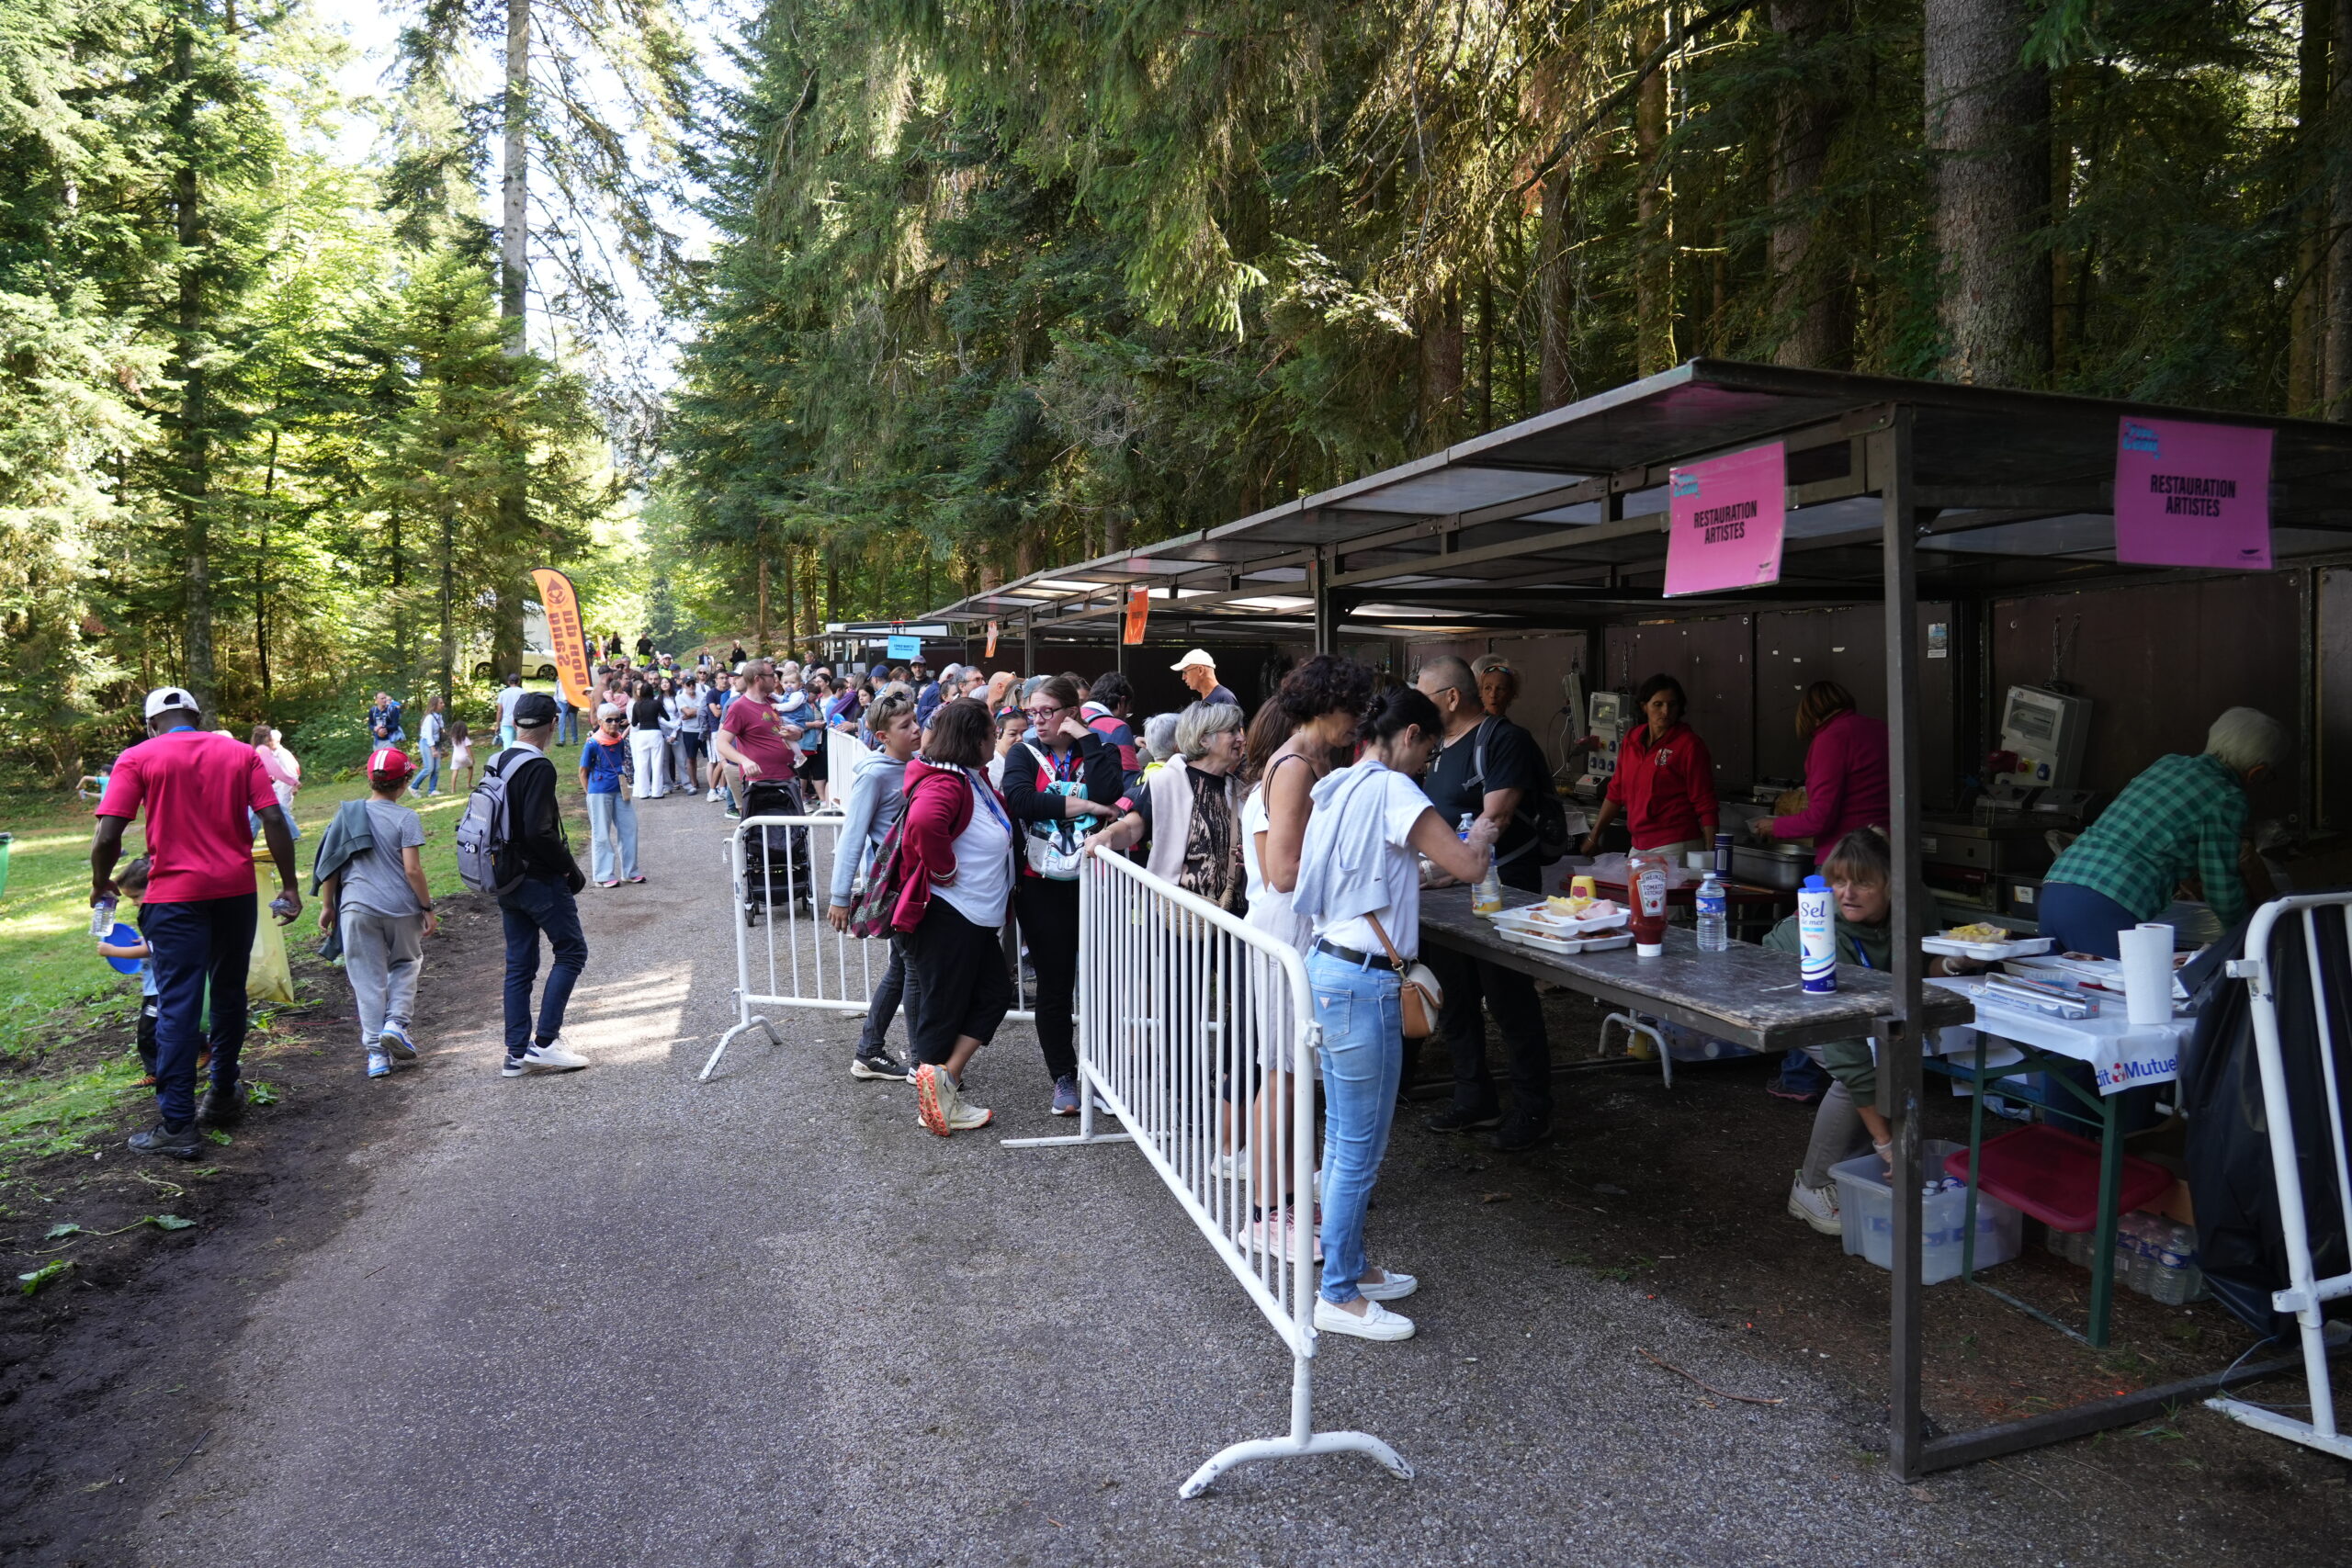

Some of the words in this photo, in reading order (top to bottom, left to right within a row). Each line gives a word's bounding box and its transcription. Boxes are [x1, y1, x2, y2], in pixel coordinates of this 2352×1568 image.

[2150, 474, 2236, 499] RESTAURATION
[1693, 500, 1758, 529] RESTAURATION
[2165, 495, 2220, 517] ARTISTES
[1704, 522, 1745, 545] ARTISTES
[1044, 763, 1054, 776] FILA
[1801, 900, 1826, 918] Sel
